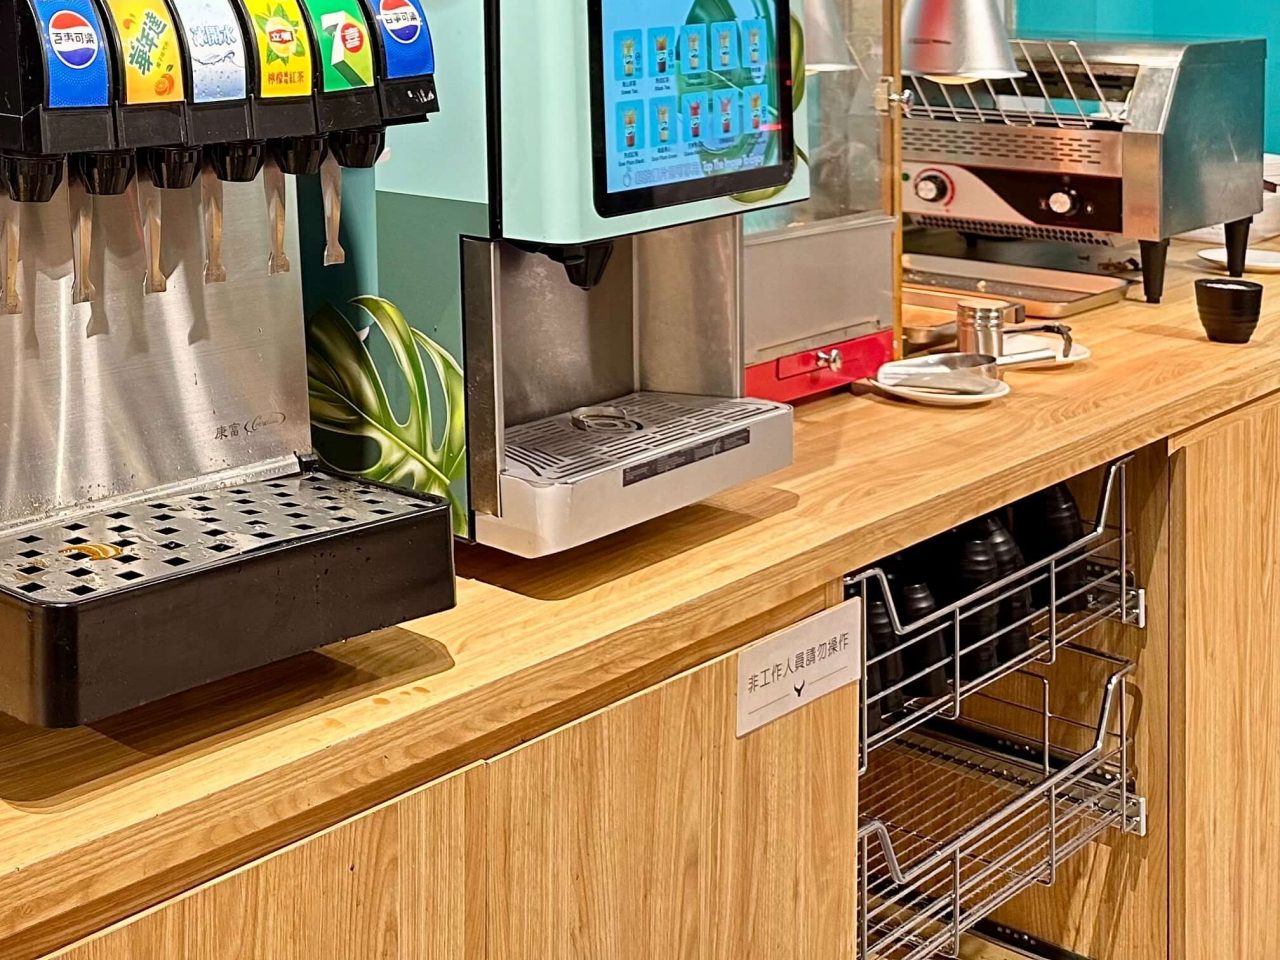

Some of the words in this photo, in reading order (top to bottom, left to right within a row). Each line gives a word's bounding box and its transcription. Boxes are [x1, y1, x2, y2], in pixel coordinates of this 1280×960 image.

[52, 32, 95, 45] 百事可樂
[747, 631, 849, 693] 非工作人員請勿操作
